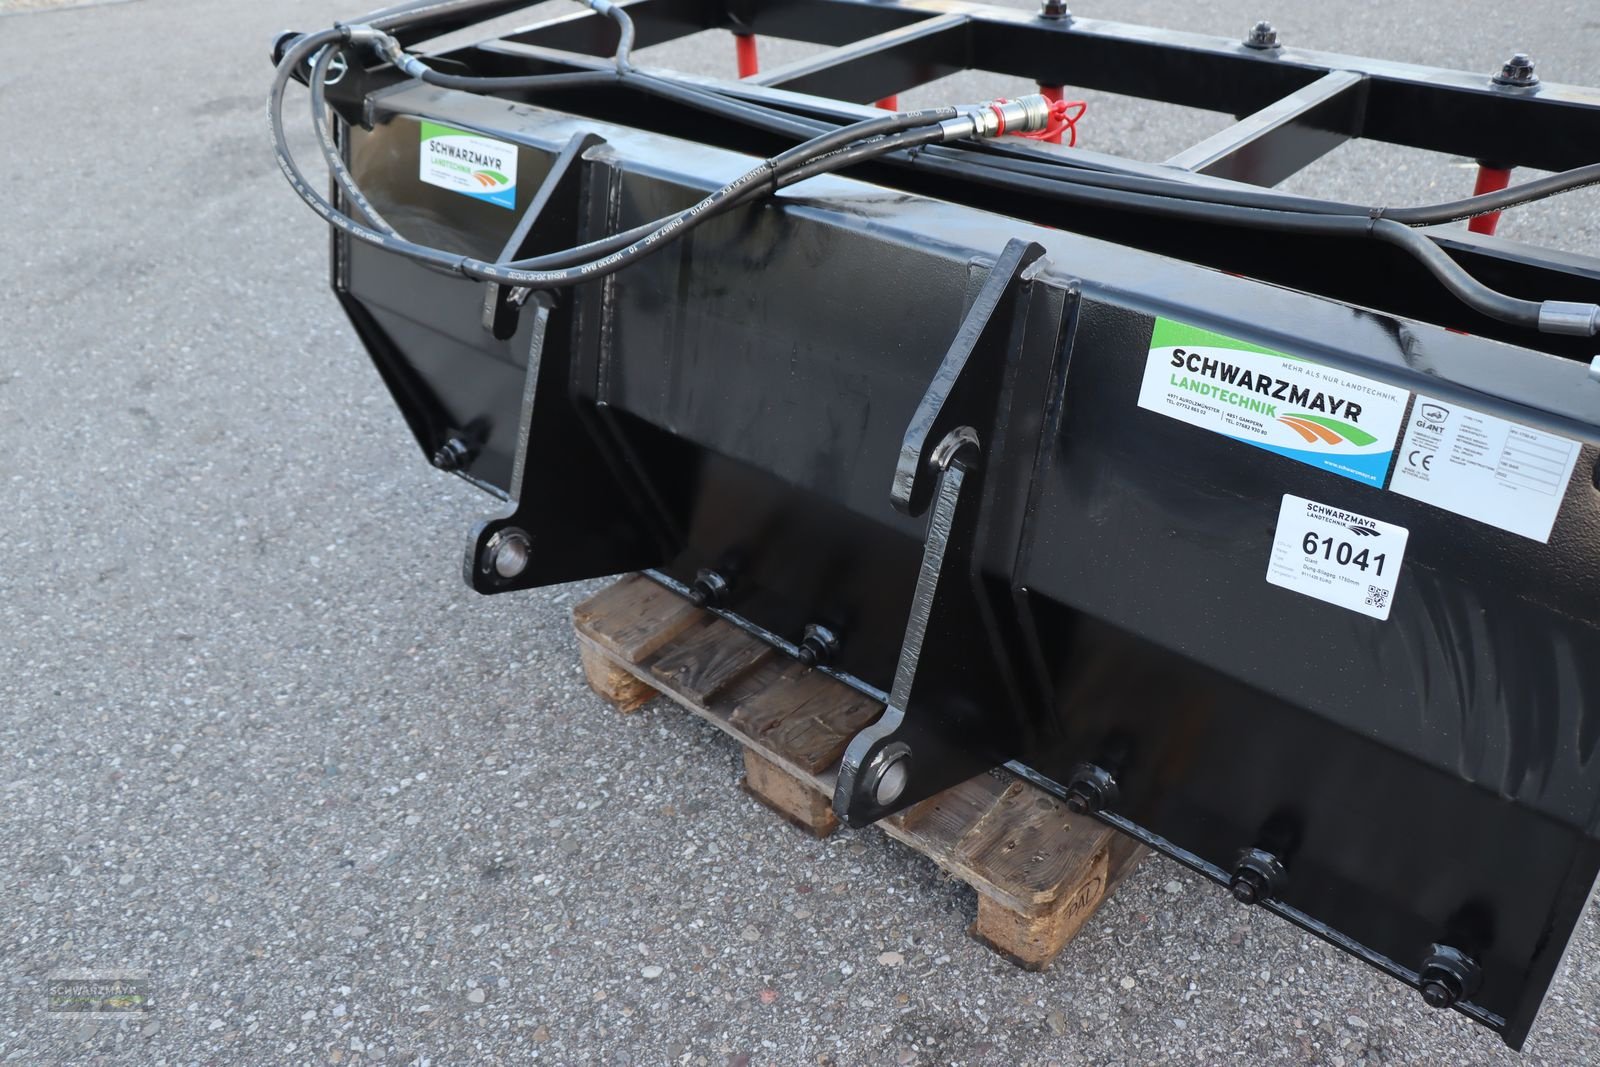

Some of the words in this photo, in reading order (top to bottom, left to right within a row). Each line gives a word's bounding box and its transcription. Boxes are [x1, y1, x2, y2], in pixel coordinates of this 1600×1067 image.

[430, 140, 502, 170] SCHWARZMAYR
[690, 198, 714, 216] KP210
[581, 264, 598, 274] BAR
[1170, 348, 1362, 423] SCHWARZMAYR
[1282, 362, 1303, 374] MEHR
[1305, 369, 1320, 379] ALS
[1322, 374, 1339, 383] NUR
[1170, 373, 1277, 418] LANDTECHNIK
[1306, 503, 1376, 529] SCHWARZMAYR
[1306, 512, 1346, 528] LANDTECHNIK
[1302, 531, 1386, 577] 61041
